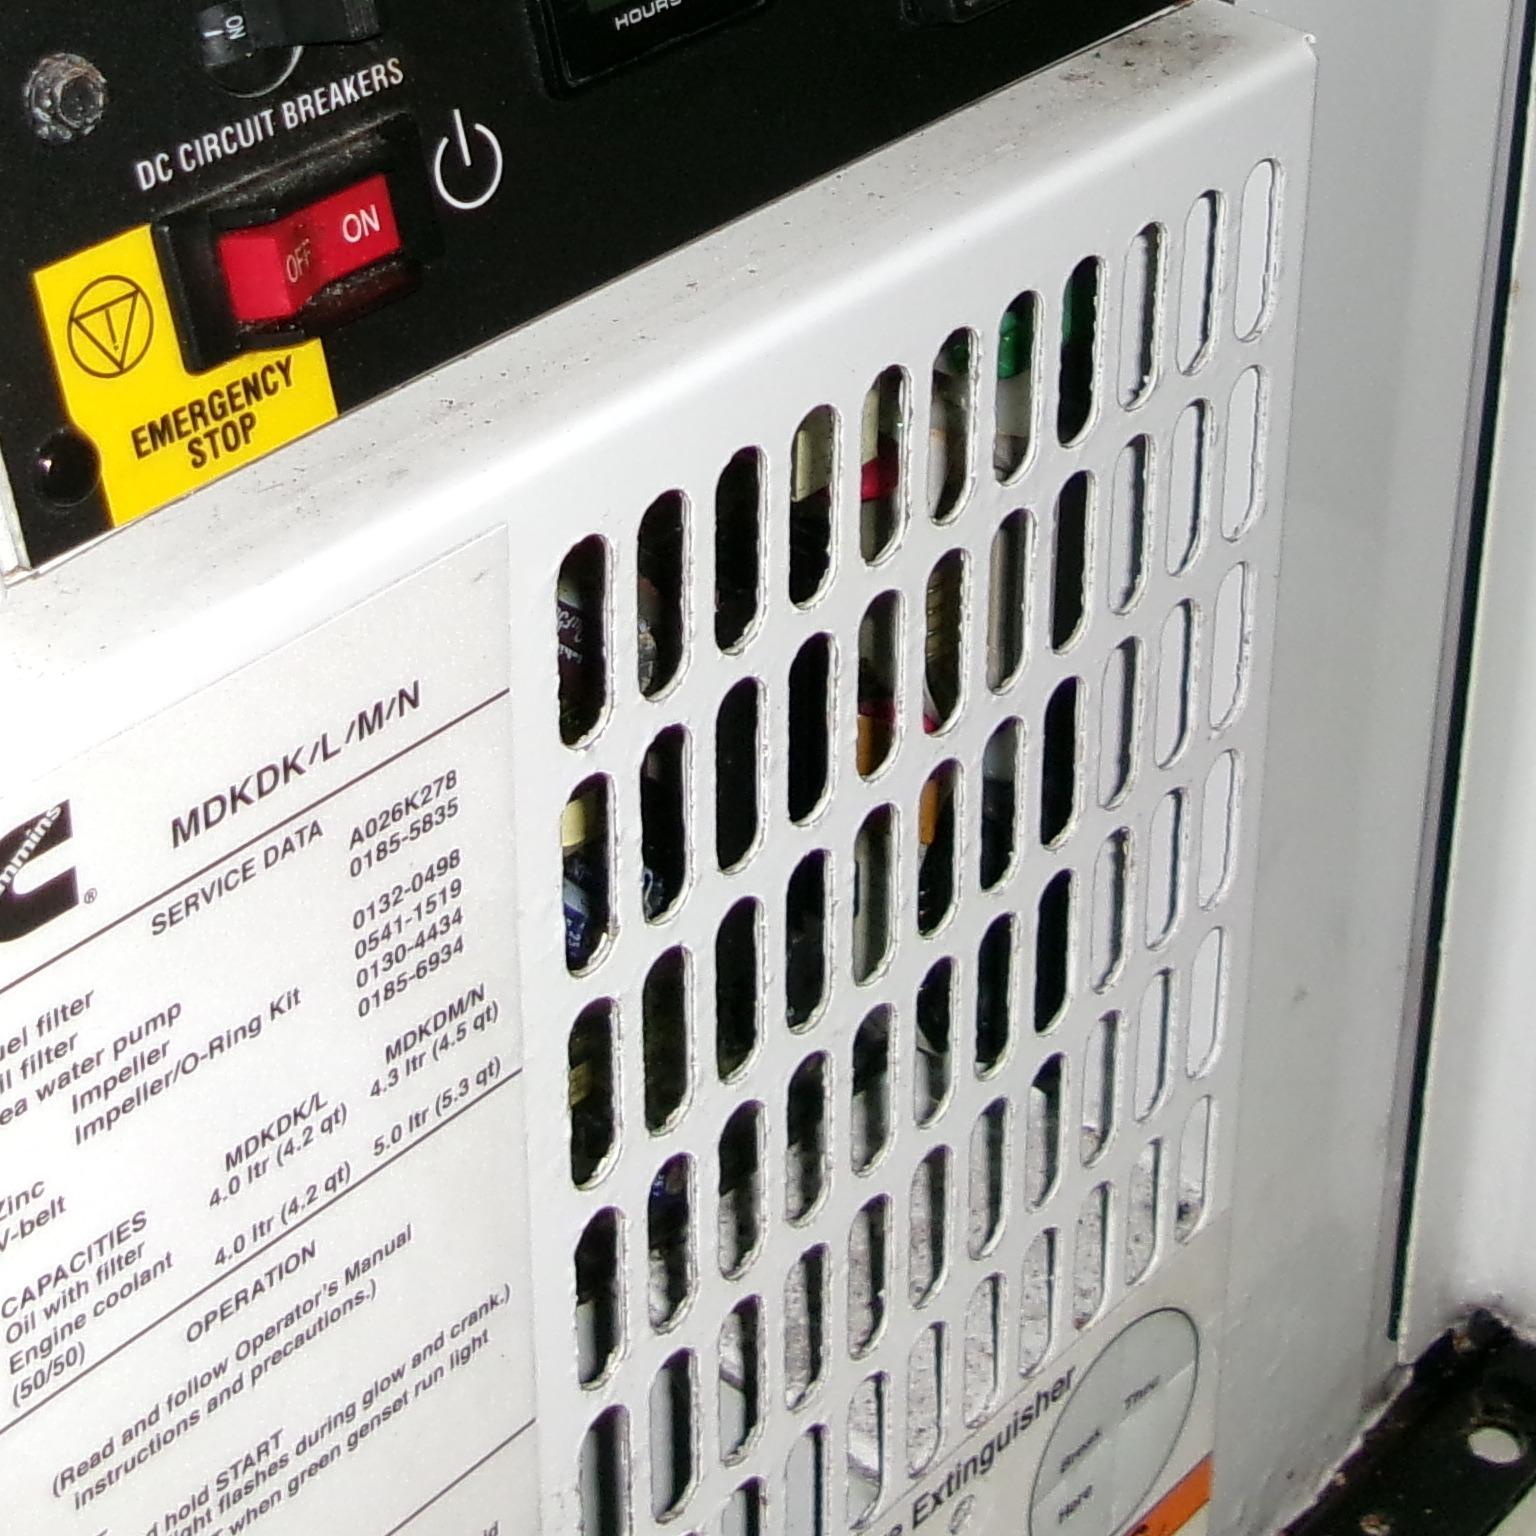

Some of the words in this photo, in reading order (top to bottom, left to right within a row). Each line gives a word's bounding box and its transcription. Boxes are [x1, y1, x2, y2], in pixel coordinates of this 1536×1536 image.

[225, 14, 246, 41] ON
[135, 154, 174, 191] DC
[179, 109, 275, 175] CIRCUIT
[281, 57, 405, 131] BREAKERS
[285, 238, 311, 284] OFF
[342, 204, 381, 244] ON
[130, 354, 297, 459] EMERGENCY
[190, 412, 258, 469] STOP
[349, 769, 458, 851] A026K278
[349, 796, 459, 878] 0185-5835
[151, 857, 257, 937] SERVICE
[264, 820, 324, 870] DATA
[353, 848, 462, 930] 0132-0498
[354, 877, 463, 960] 0541-1519
[356, 905, 464, 989] 0130-4434
[358, 934, 465, 1018] 0185-6934
[19, 1032, 79, 1080] filter
[35, 1048, 105, 1102] water
[112, 1002, 183, 1062] pump
[36, 989, 95, 1037] filter
[369, 1066, 400, 1098] 4.3
[405, 1049, 428, 1077] ltr
[431, 1023, 468, 1063] (4.5
[473, 999, 500, 1032] qt)
[384, 982, 486, 1064] MDKDM/N
[71, 1039, 171, 1115] Impeller
[75, 1014, 263, 1146] Impeller/O-Ring
[269, 986, 302, 1023] Kit
[372, 1123, 403, 1157] 5.0
[408, 1106, 430, 1133] ltr
[434, 1077, 470, 1118] (5.3
[475, 1055, 502, 1087] qt)
[209, 1175, 241, 1208] 4.0
[247, 1157, 271, 1185] ltr
[275, 1125, 314, 1168] (4.2
[320, 1101, 348, 1135] qt)
[225, 1091, 329, 1172] MDKDK/L
[214, 1233, 247, 1266] 4.0
[252, 1216, 275, 1243] ltr
[280, 1183, 319, 1226] (4.2
[324, 1160, 352, 1194] qt)
[0, 1209, 148, 1320] CAPACITIES
[5, 1318, 37, 1345] Oil
[43, 1280, 90, 1322] with
[95, 1240, 146, 1286] filter
[8, 1312, 87, 1375] Engine
[92, 1250, 174, 1318] coolant
[185, 1239, 317, 1344] OPERATION
[12, 1340, 86, 1409] (50/50)
[52, 1437, 115, 1499] (Read
[121, 1403, 161, 1446] and
[165, 1355, 229, 1413] follow
[235, 1280, 339, 1362] Operator's
[344, 1223, 413, 1286] Manual
[74, 1408, 201, 1511] instructions
[207, 1374, 244, 1414] and
[250, 1278, 377, 1390] precautions.)
[219, 1455, 290, 1515] flashes
[295, 1400, 357, 1457] during
[362, 1363, 407, 1411] glow
[411, 1330, 445, 1369] and
[450, 1282, 512, 1340] crank.)
[165, 1485, 210, 1532] hold
[215, 1427, 284, 1492] START
[228, 1488, 282, 1536] when
[287, 1442, 342, 1498] green
[347, 1389, 409, 1452] genset
[414, 1365, 445, 1398] run
[449, 1328, 490, 1370] light
[912, 1365, 1077, 1531] Extinguisher
